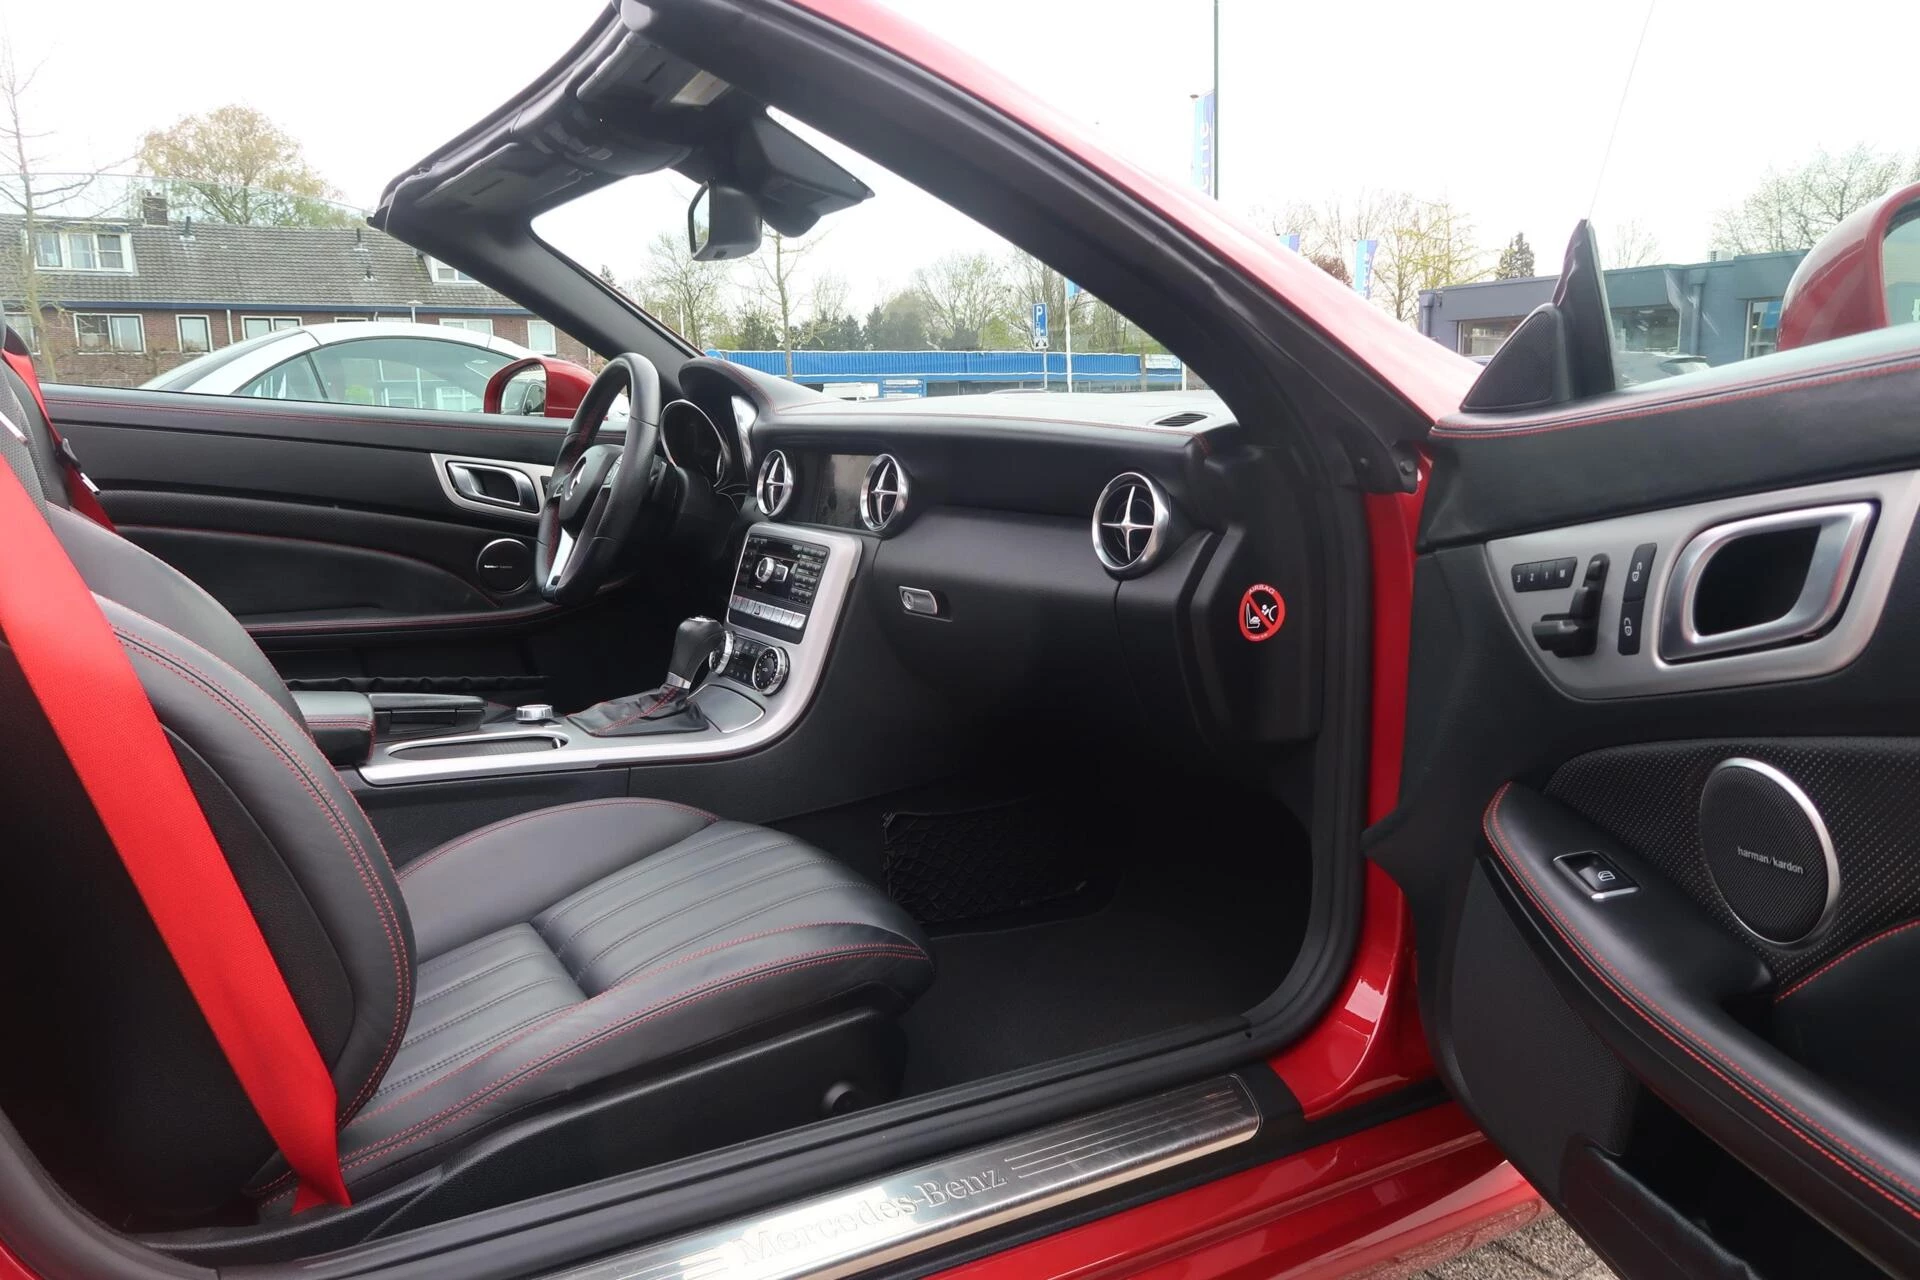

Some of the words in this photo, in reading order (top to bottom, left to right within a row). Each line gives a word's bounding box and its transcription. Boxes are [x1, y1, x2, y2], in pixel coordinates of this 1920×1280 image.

[1036, 305, 1043, 322] P
[1249, 584, 1275, 595] AIRBAG
[733, 1167, 1008, 1265] Mercedes-Benz
